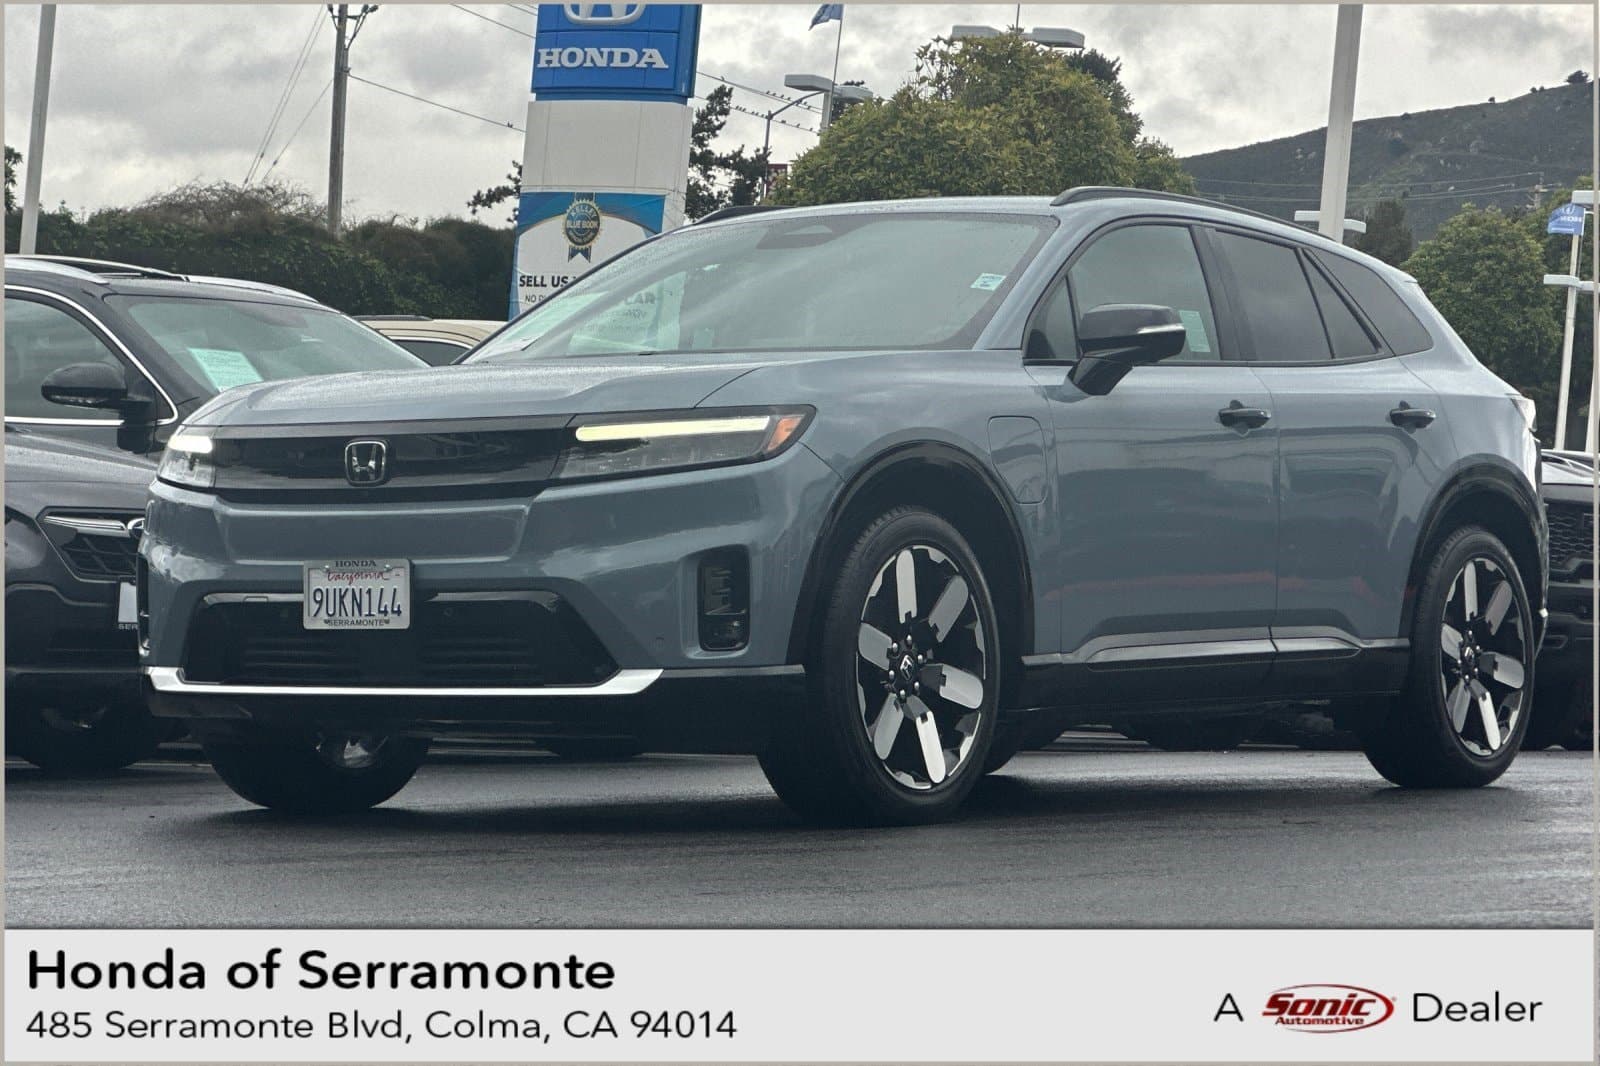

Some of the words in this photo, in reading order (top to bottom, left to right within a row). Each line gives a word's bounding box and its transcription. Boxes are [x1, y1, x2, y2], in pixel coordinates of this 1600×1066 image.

[537, 47, 669, 69] HONDA
[519, 275, 547, 288] SELL
[551, 275, 569, 288] US
[525, 294, 537, 303] NO
[335, 560, 377, 568] HONDA
[327, 570, 391, 586] California
[312, 587, 403, 617] 9UKN144
[328, 618, 385, 627] SERRAMONTE
